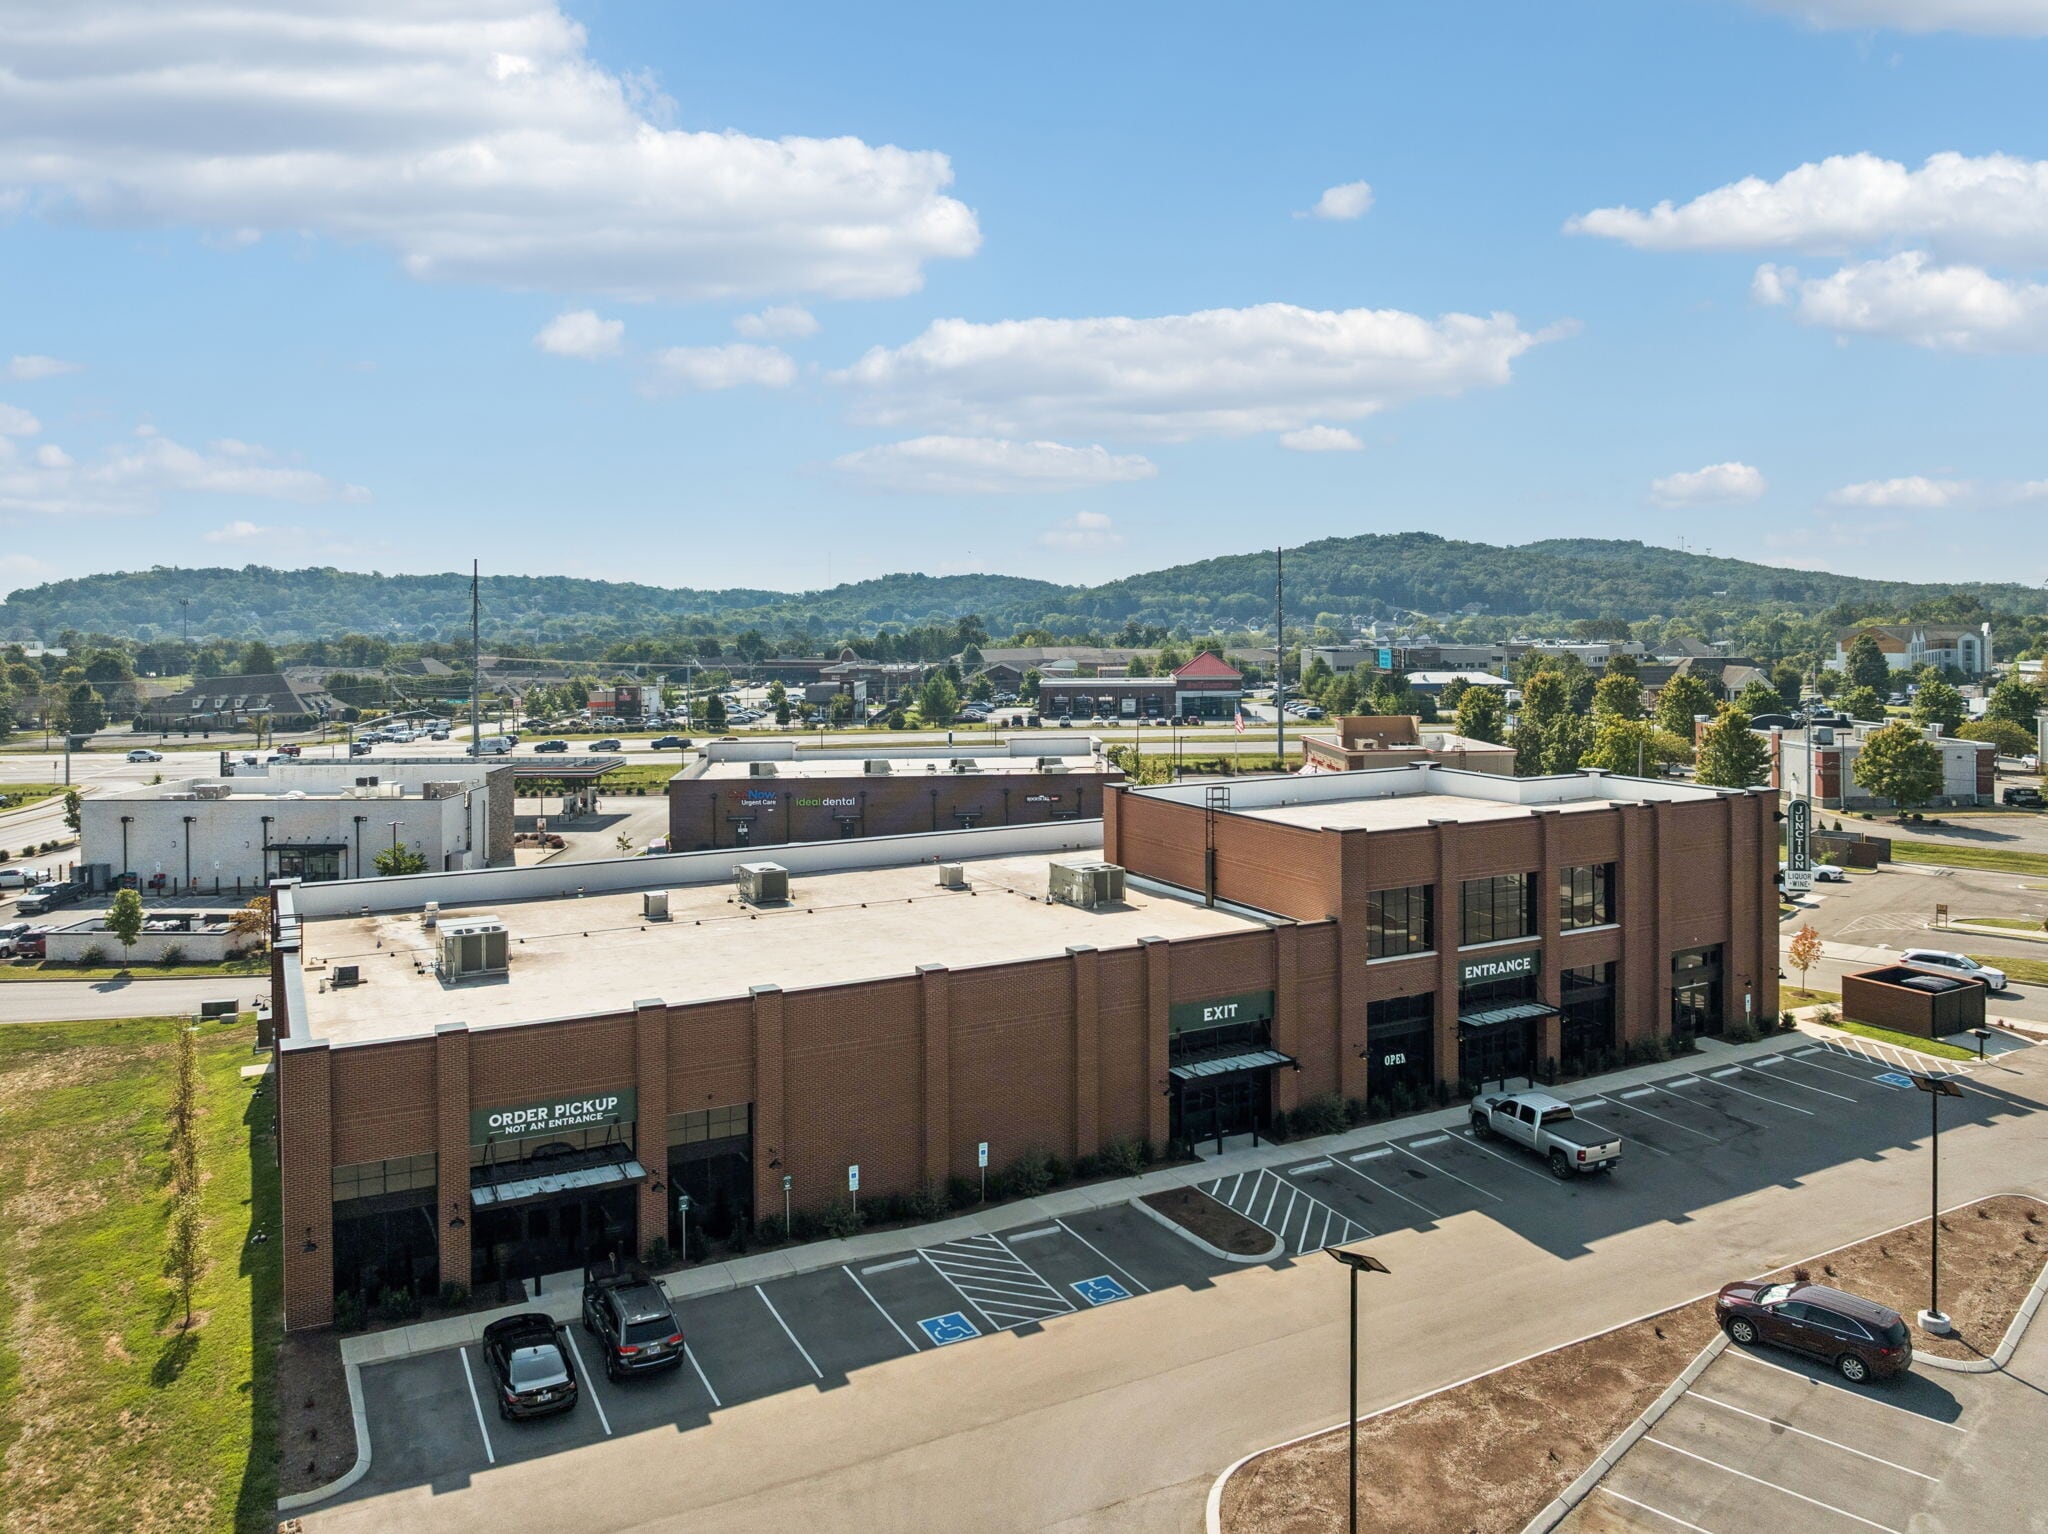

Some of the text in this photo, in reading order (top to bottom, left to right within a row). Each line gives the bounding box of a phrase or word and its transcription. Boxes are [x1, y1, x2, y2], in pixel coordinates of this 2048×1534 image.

[741, 799, 762, 807] Urgent
[796, 796, 855, 806] ideal dental
[1795, 805, 1804, 869] JUNCTION
[1787, 872, 1812, 880] LIQUOR
[1792, 880, 1808, 888] WINE
[1465, 957, 1531, 979] ENTRANCE
[1203, 1003, 1238, 1021] EXIT
[1384, 1052, 1406, 1066] OPEN
[488, 1097, 618, 1127] ORDER PICKUP
[505, 1112, 604, 1134] NOT AN ENTRANCE
